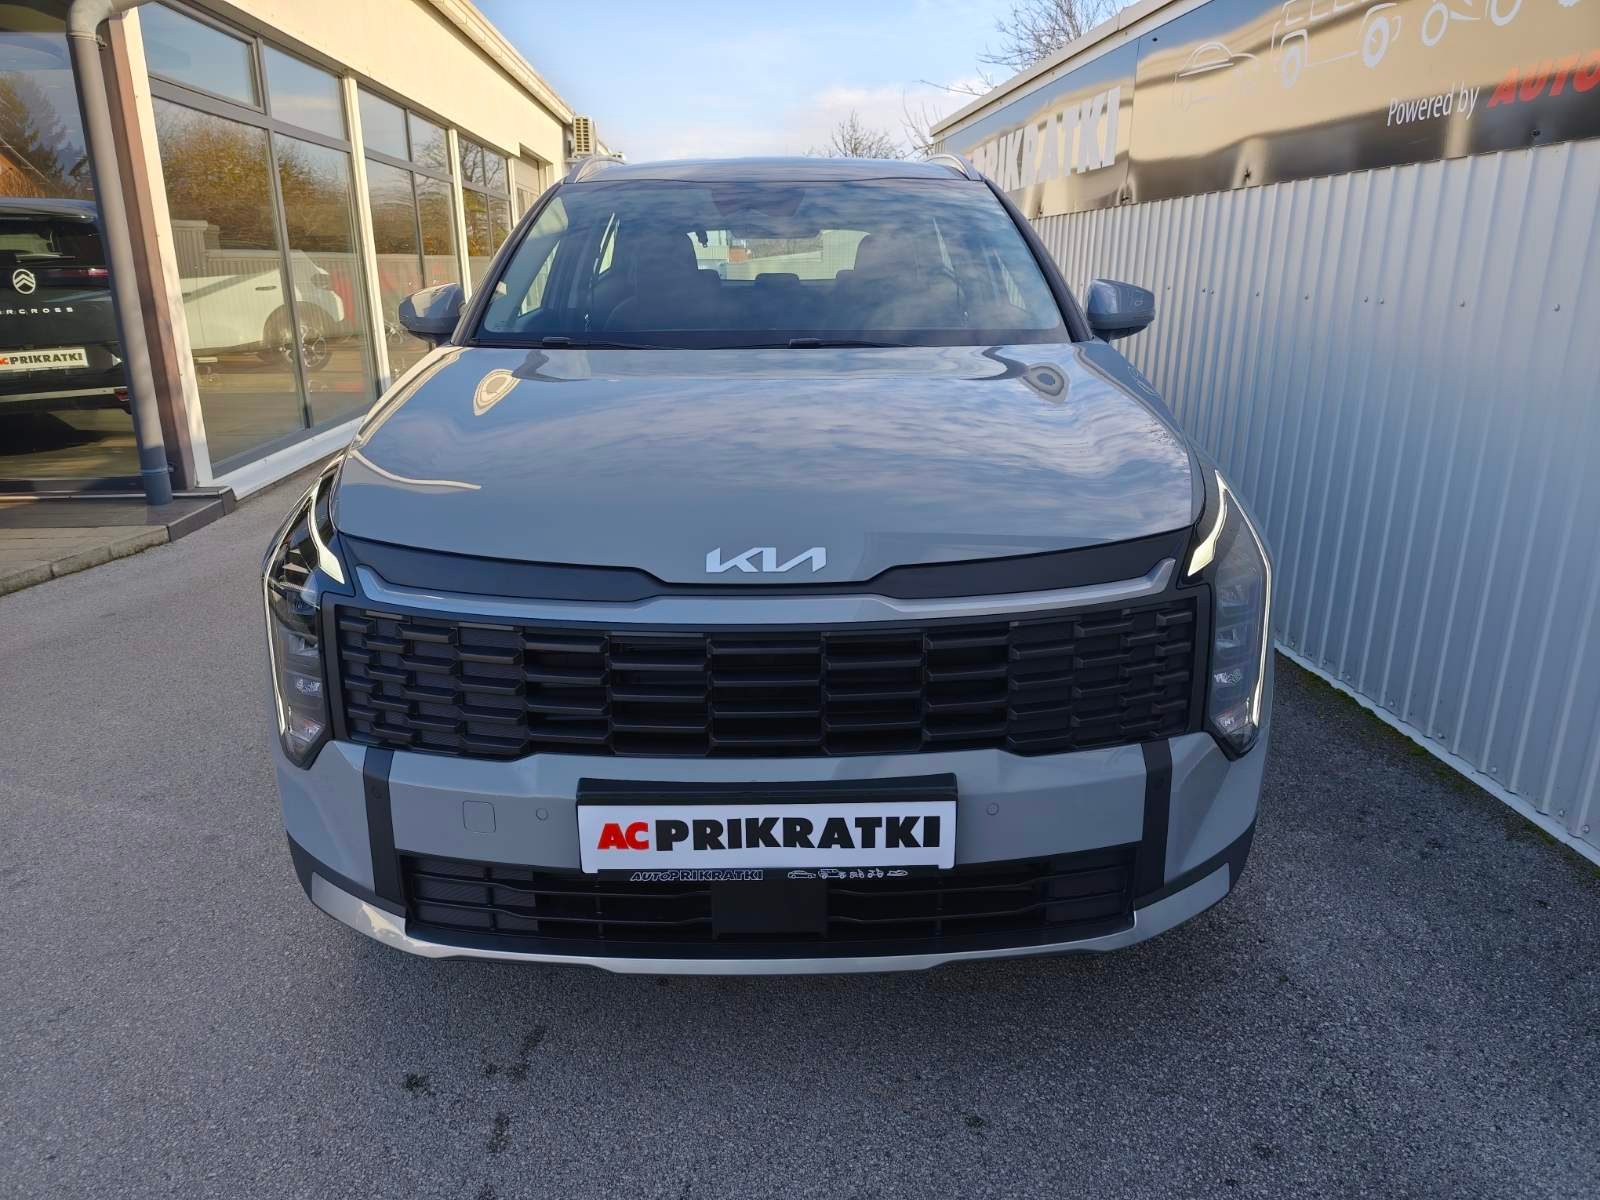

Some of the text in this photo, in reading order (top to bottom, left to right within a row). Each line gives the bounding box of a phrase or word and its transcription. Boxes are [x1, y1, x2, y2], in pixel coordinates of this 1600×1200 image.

[1387, 48, 1600, 127] Powered by AUTO
[0, 307, 74, 315] RCROSS
[706, 547, 827, 573] KIA
[630, 869, 764, 882] AUTOPRIKRATKI
